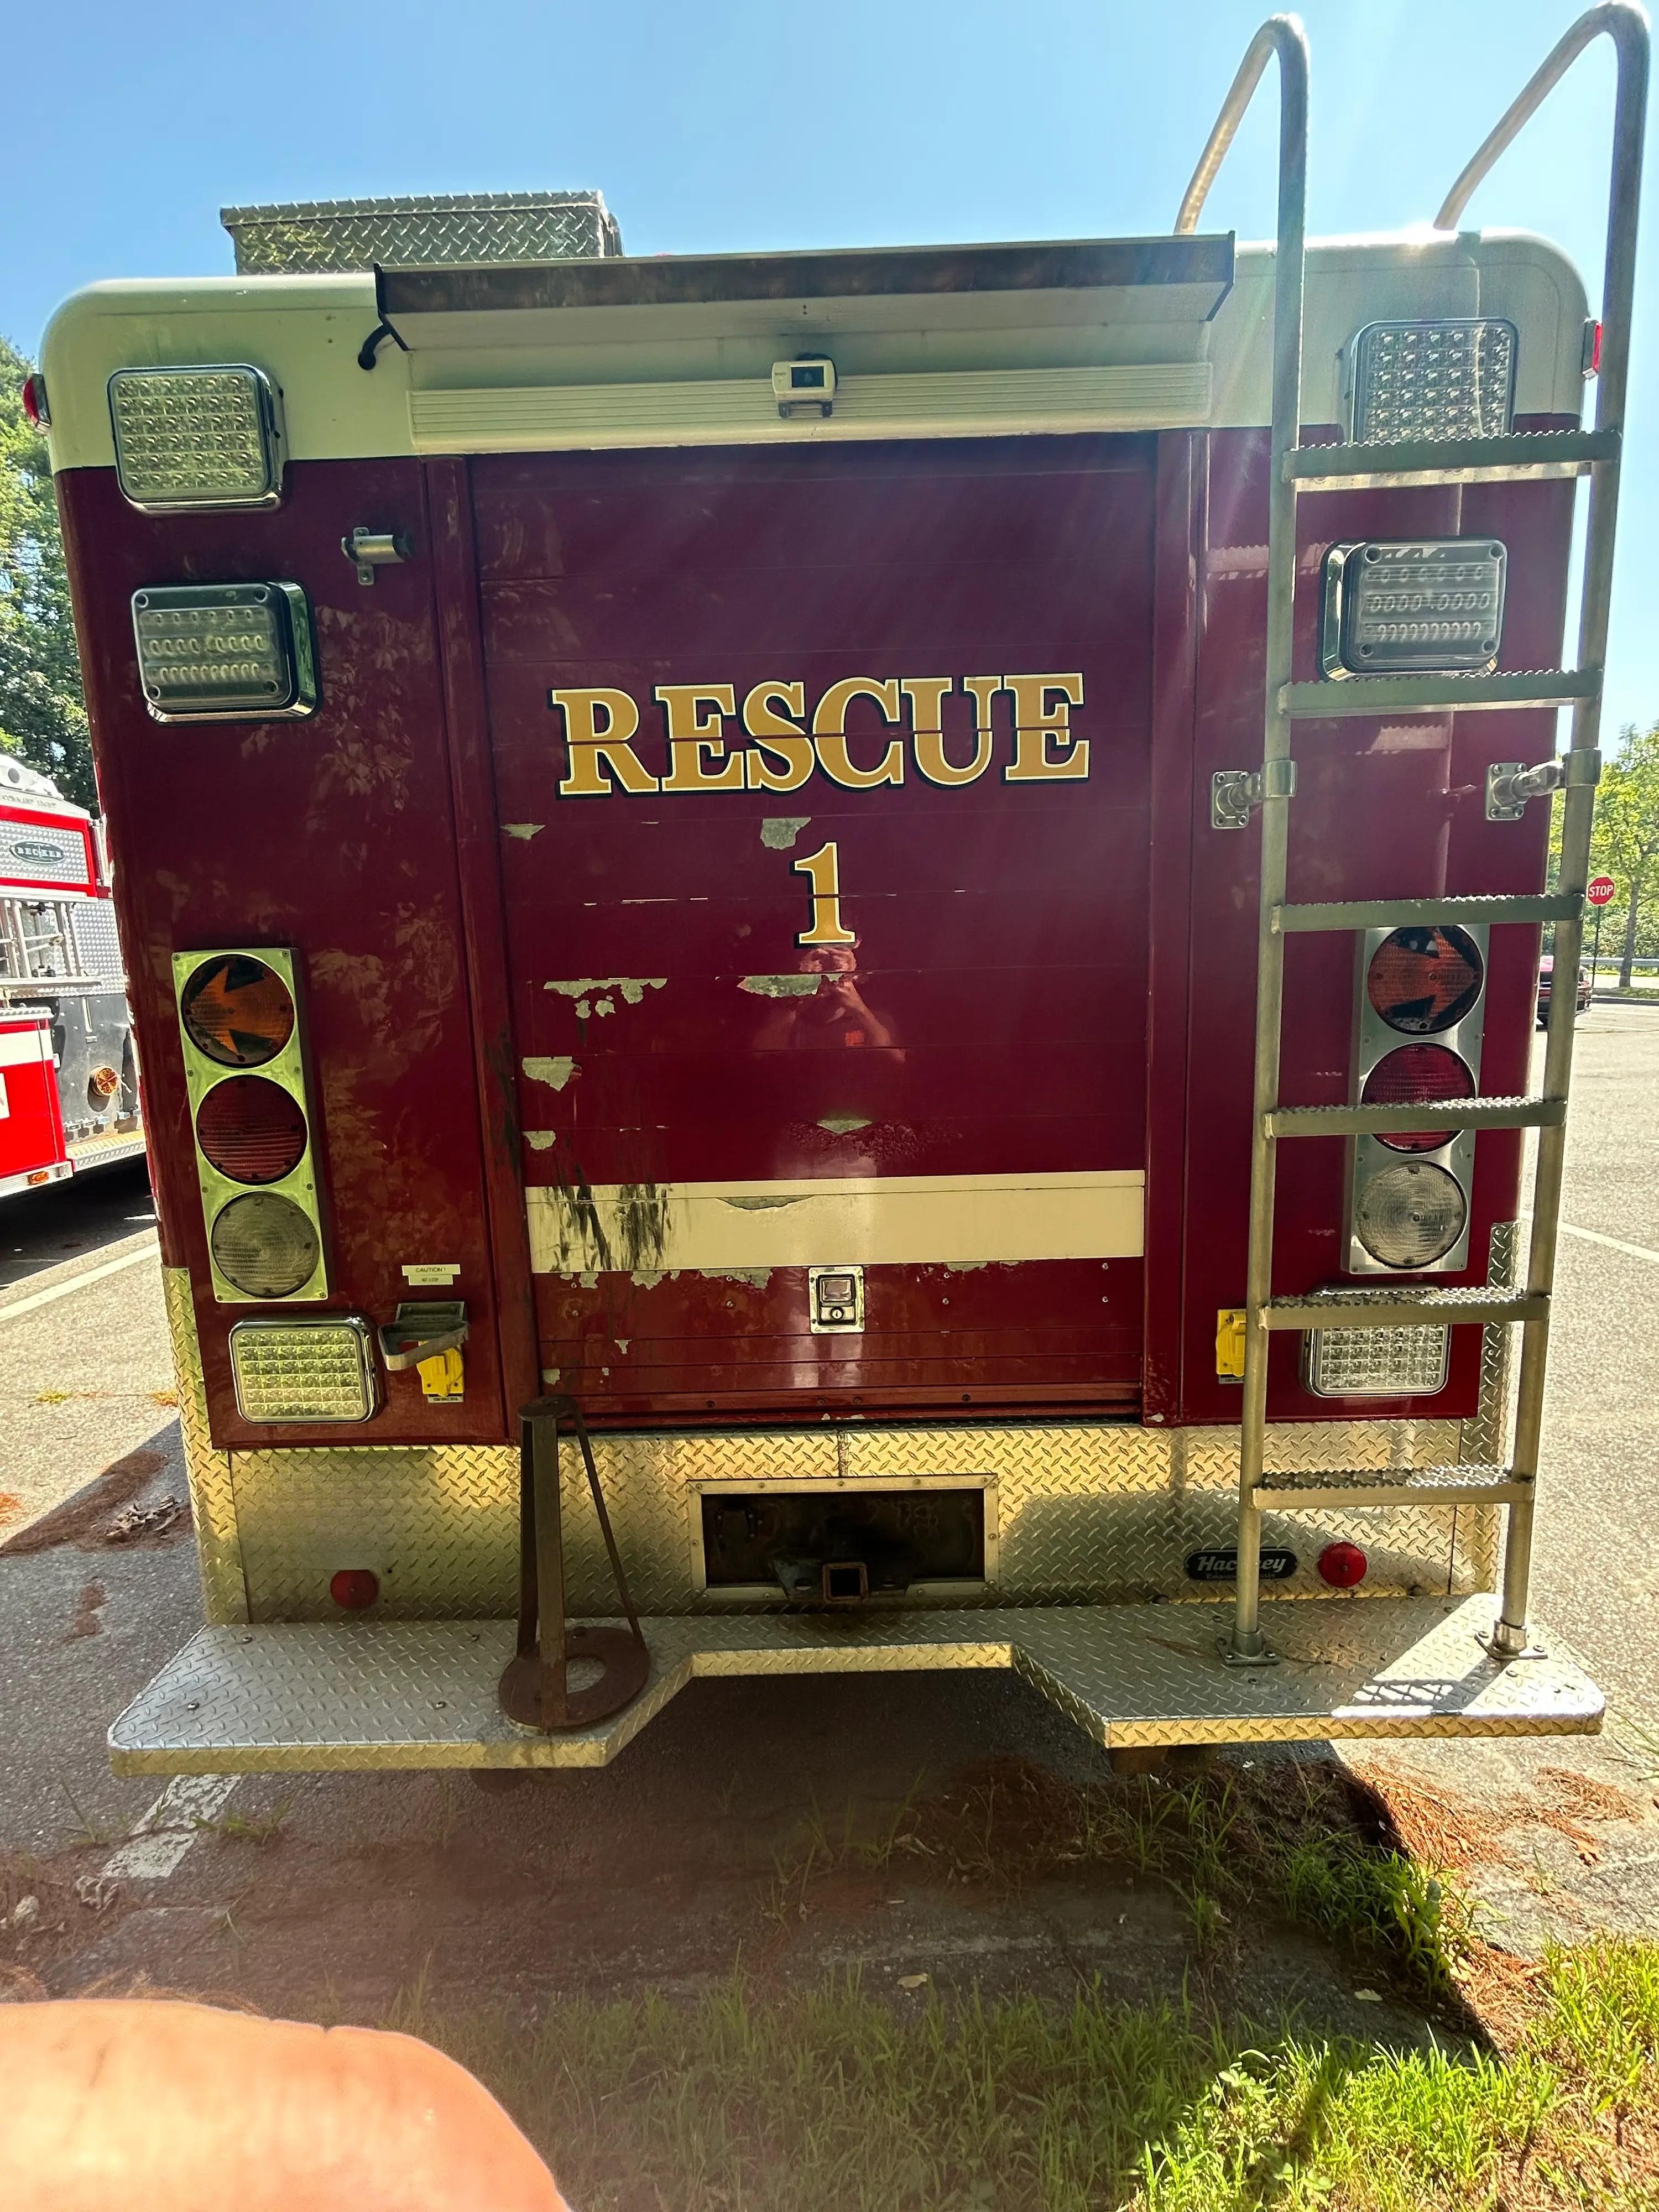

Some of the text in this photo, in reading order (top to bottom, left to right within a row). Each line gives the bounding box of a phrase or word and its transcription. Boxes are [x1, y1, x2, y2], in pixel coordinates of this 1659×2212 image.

[550, 673, 1090, 795] RESCUE
[17, 847, 62, 858] BECKER
[792, 842, 855, 945] 1
[1589, 885, 1613, 897] STOP
[1197, 1556, 1286, 1573] Hacey
